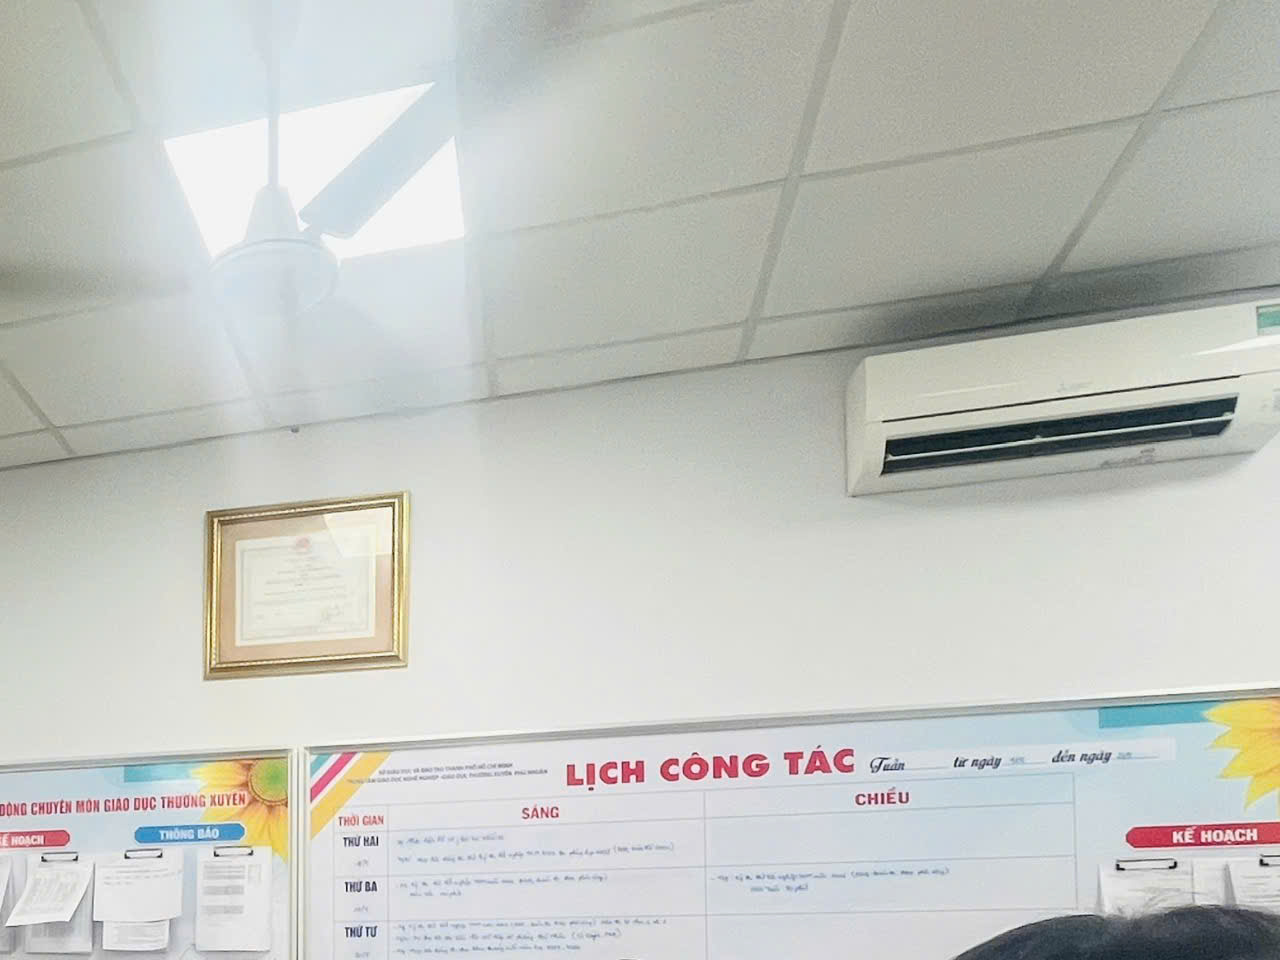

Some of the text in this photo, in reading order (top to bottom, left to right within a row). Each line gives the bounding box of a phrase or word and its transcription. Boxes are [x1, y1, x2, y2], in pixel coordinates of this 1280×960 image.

[566, 745, 855, 791] LỊCH CÔNG TÁC
[521, 804, 560, 820] SÁNG
[1172, 825, 1258, 845] KẾ HOẠCH
[365, 881, 378, 892] BA
